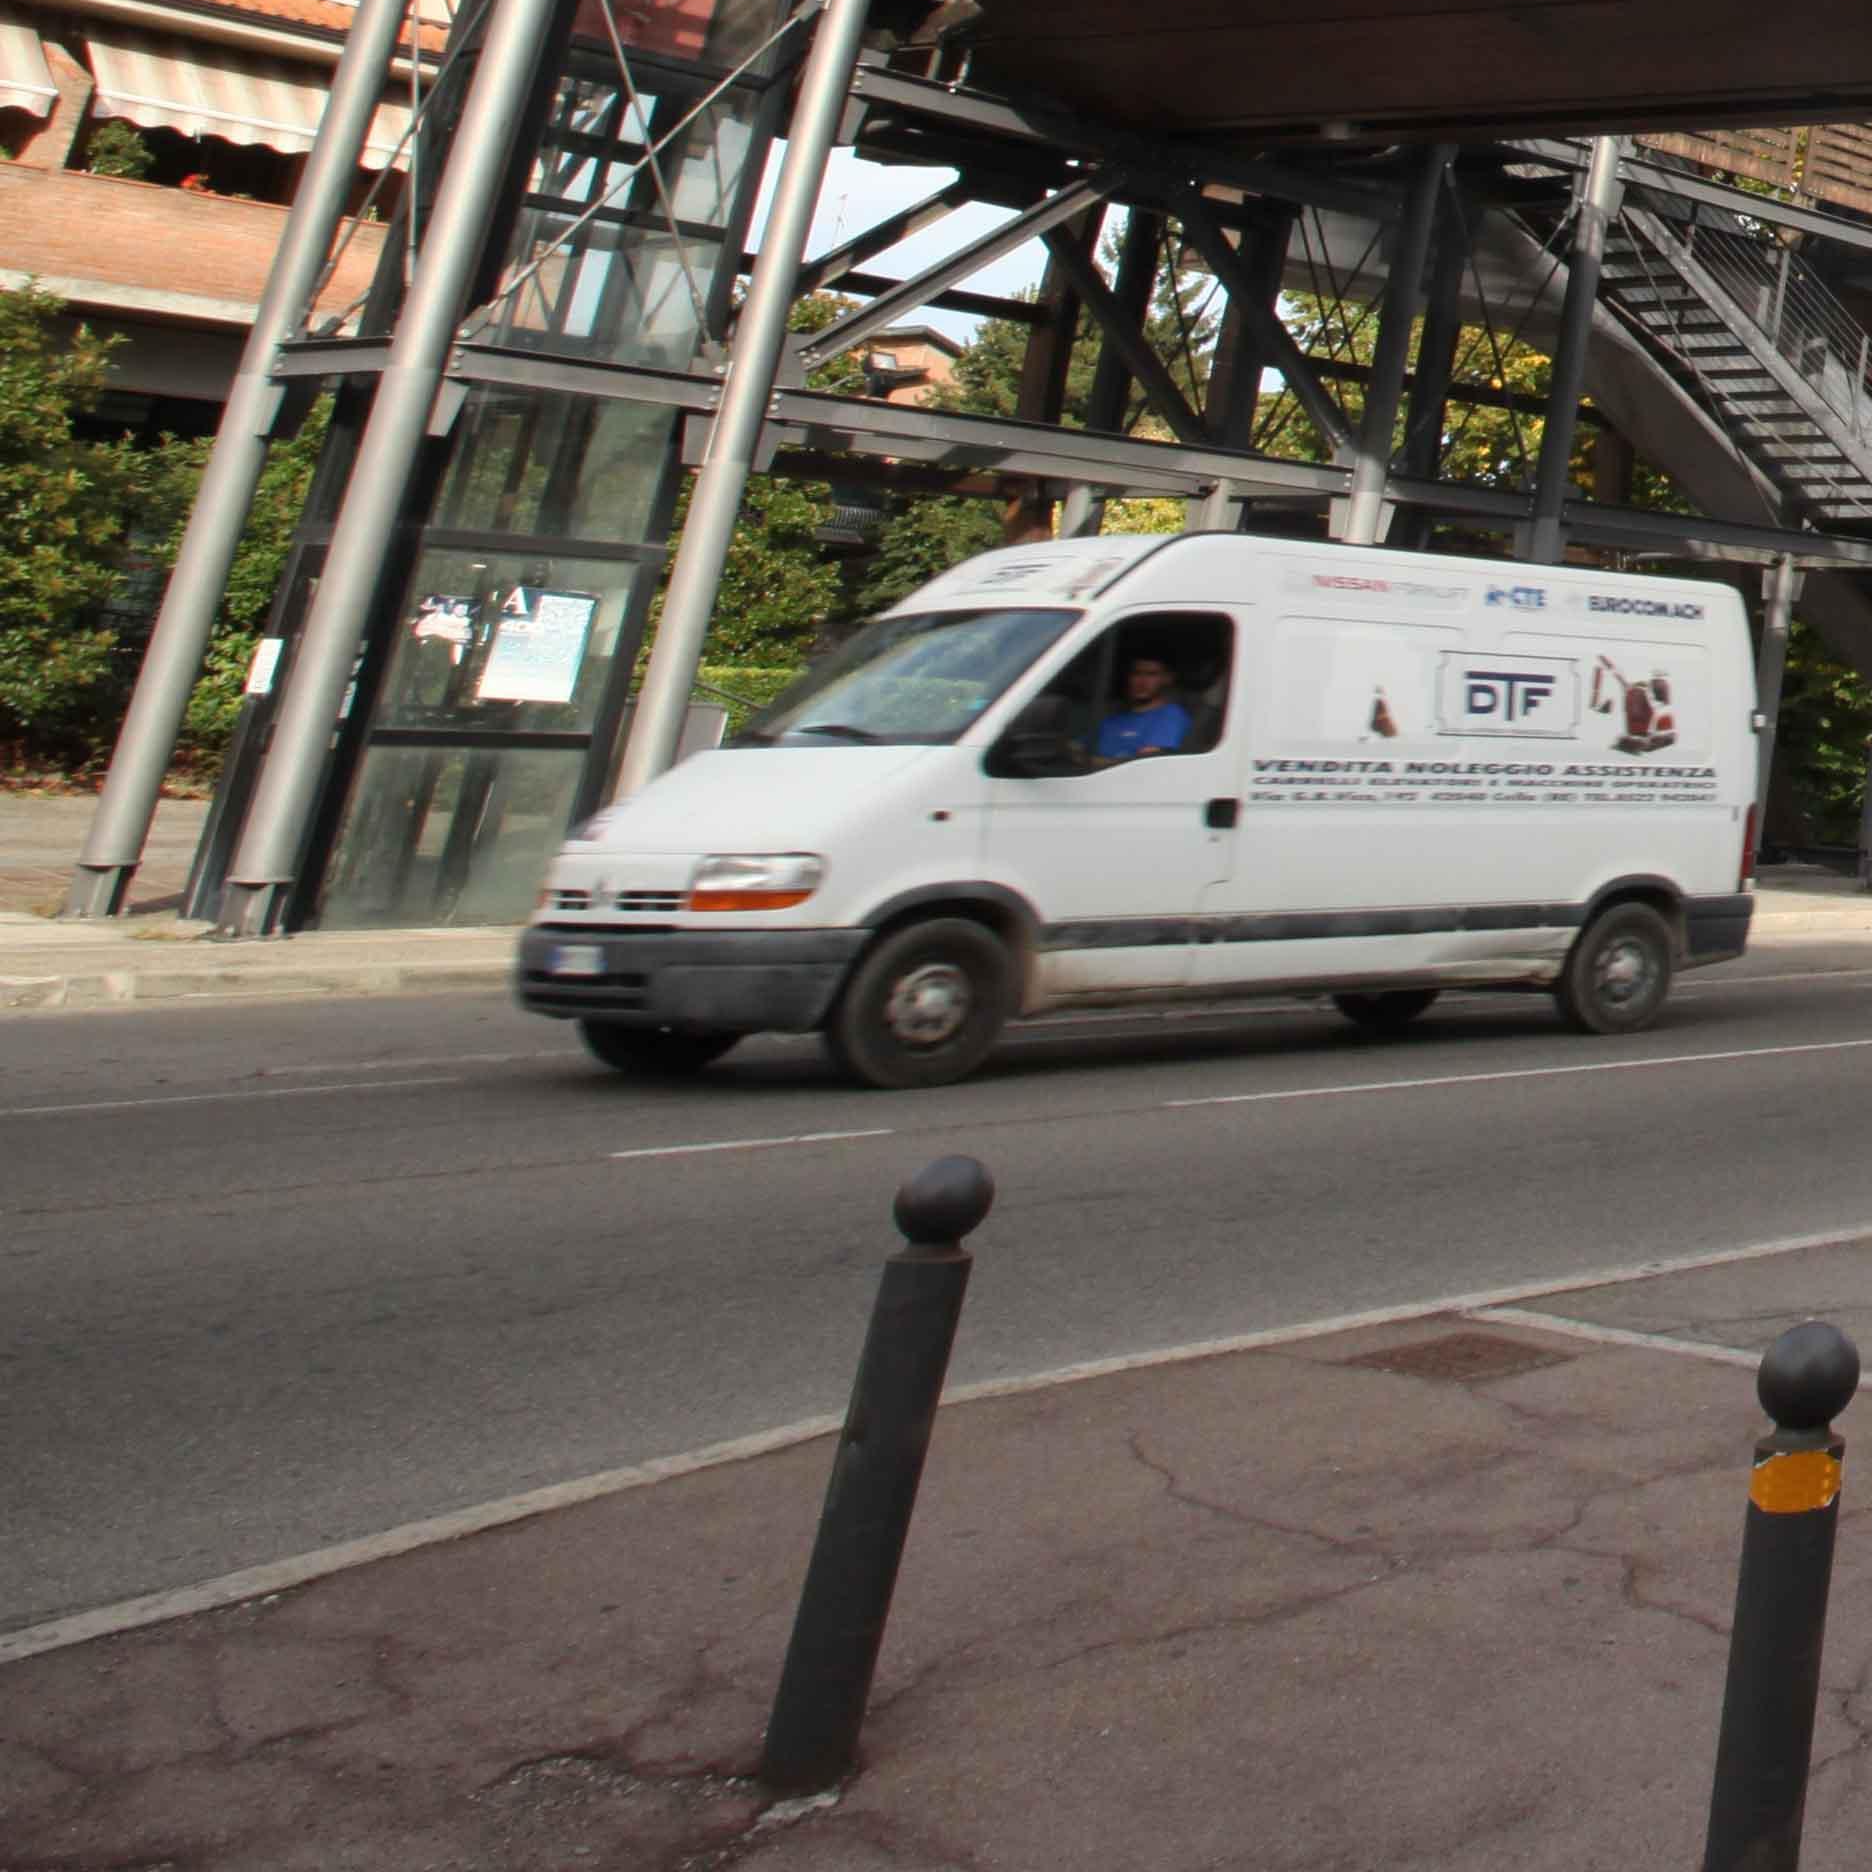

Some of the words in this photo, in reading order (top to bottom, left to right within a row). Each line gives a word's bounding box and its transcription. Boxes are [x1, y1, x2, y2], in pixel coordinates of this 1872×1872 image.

[1464, 671, 1556, 721] DTF
[1252, 760, 1393, 773] VENDITA
[1404, 762, 1555, 776] NOLEGGIO
[1563, 765, 1717, 778] ASSISTENZA
